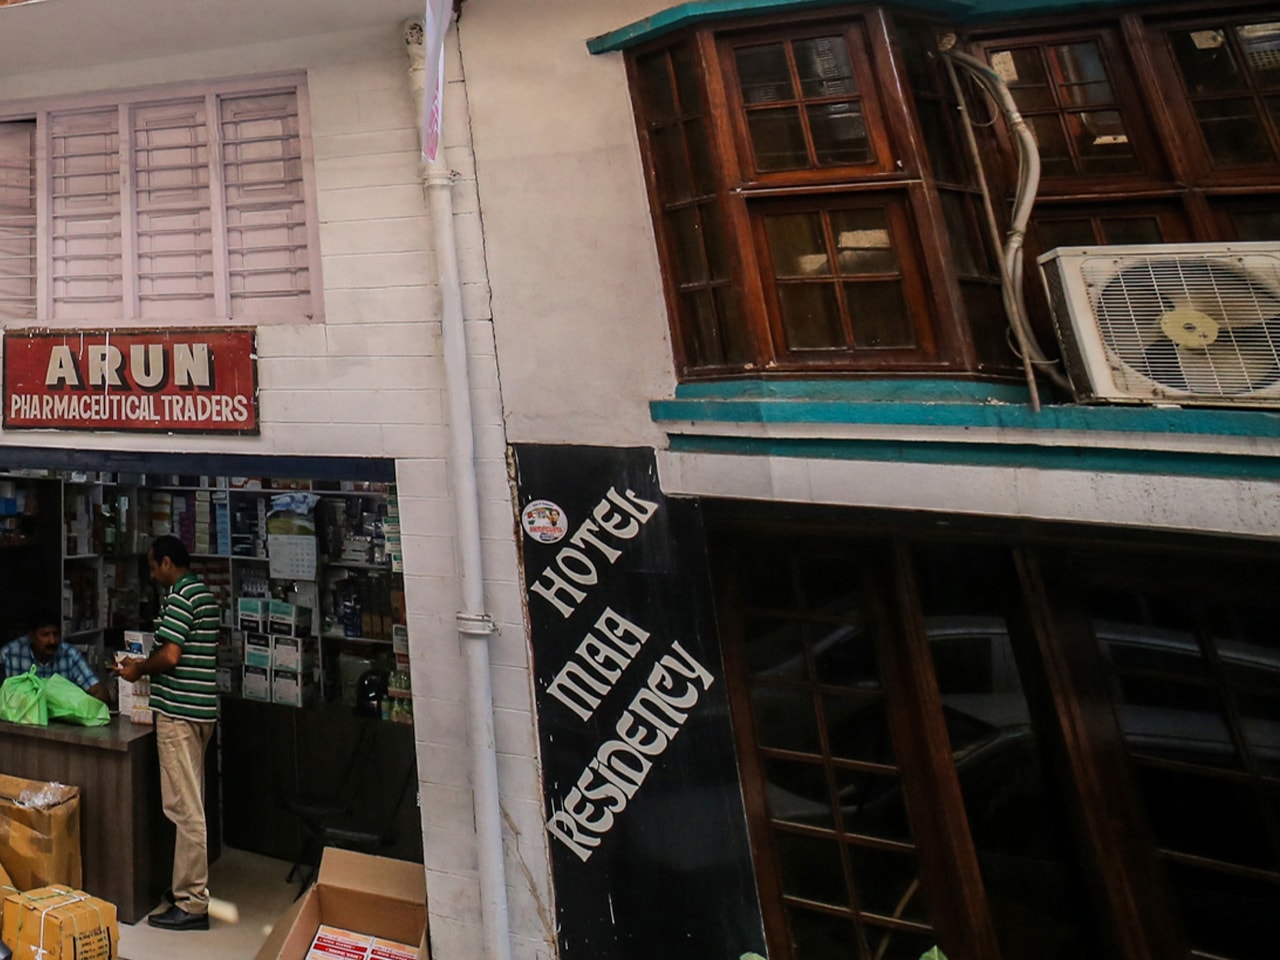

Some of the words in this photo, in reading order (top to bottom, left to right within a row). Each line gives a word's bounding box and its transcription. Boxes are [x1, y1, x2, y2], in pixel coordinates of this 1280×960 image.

[11, 394, 161, 421] PHARMACEUTICAL
[161, 394, 248, 422] TRADERS
[45, 343, 212, 389] ARUN
[530, 486, 659, 619] HOTEL
[546, 606, 650, 722] MAA
[546, 640, 715, 862] RESIDENCY
